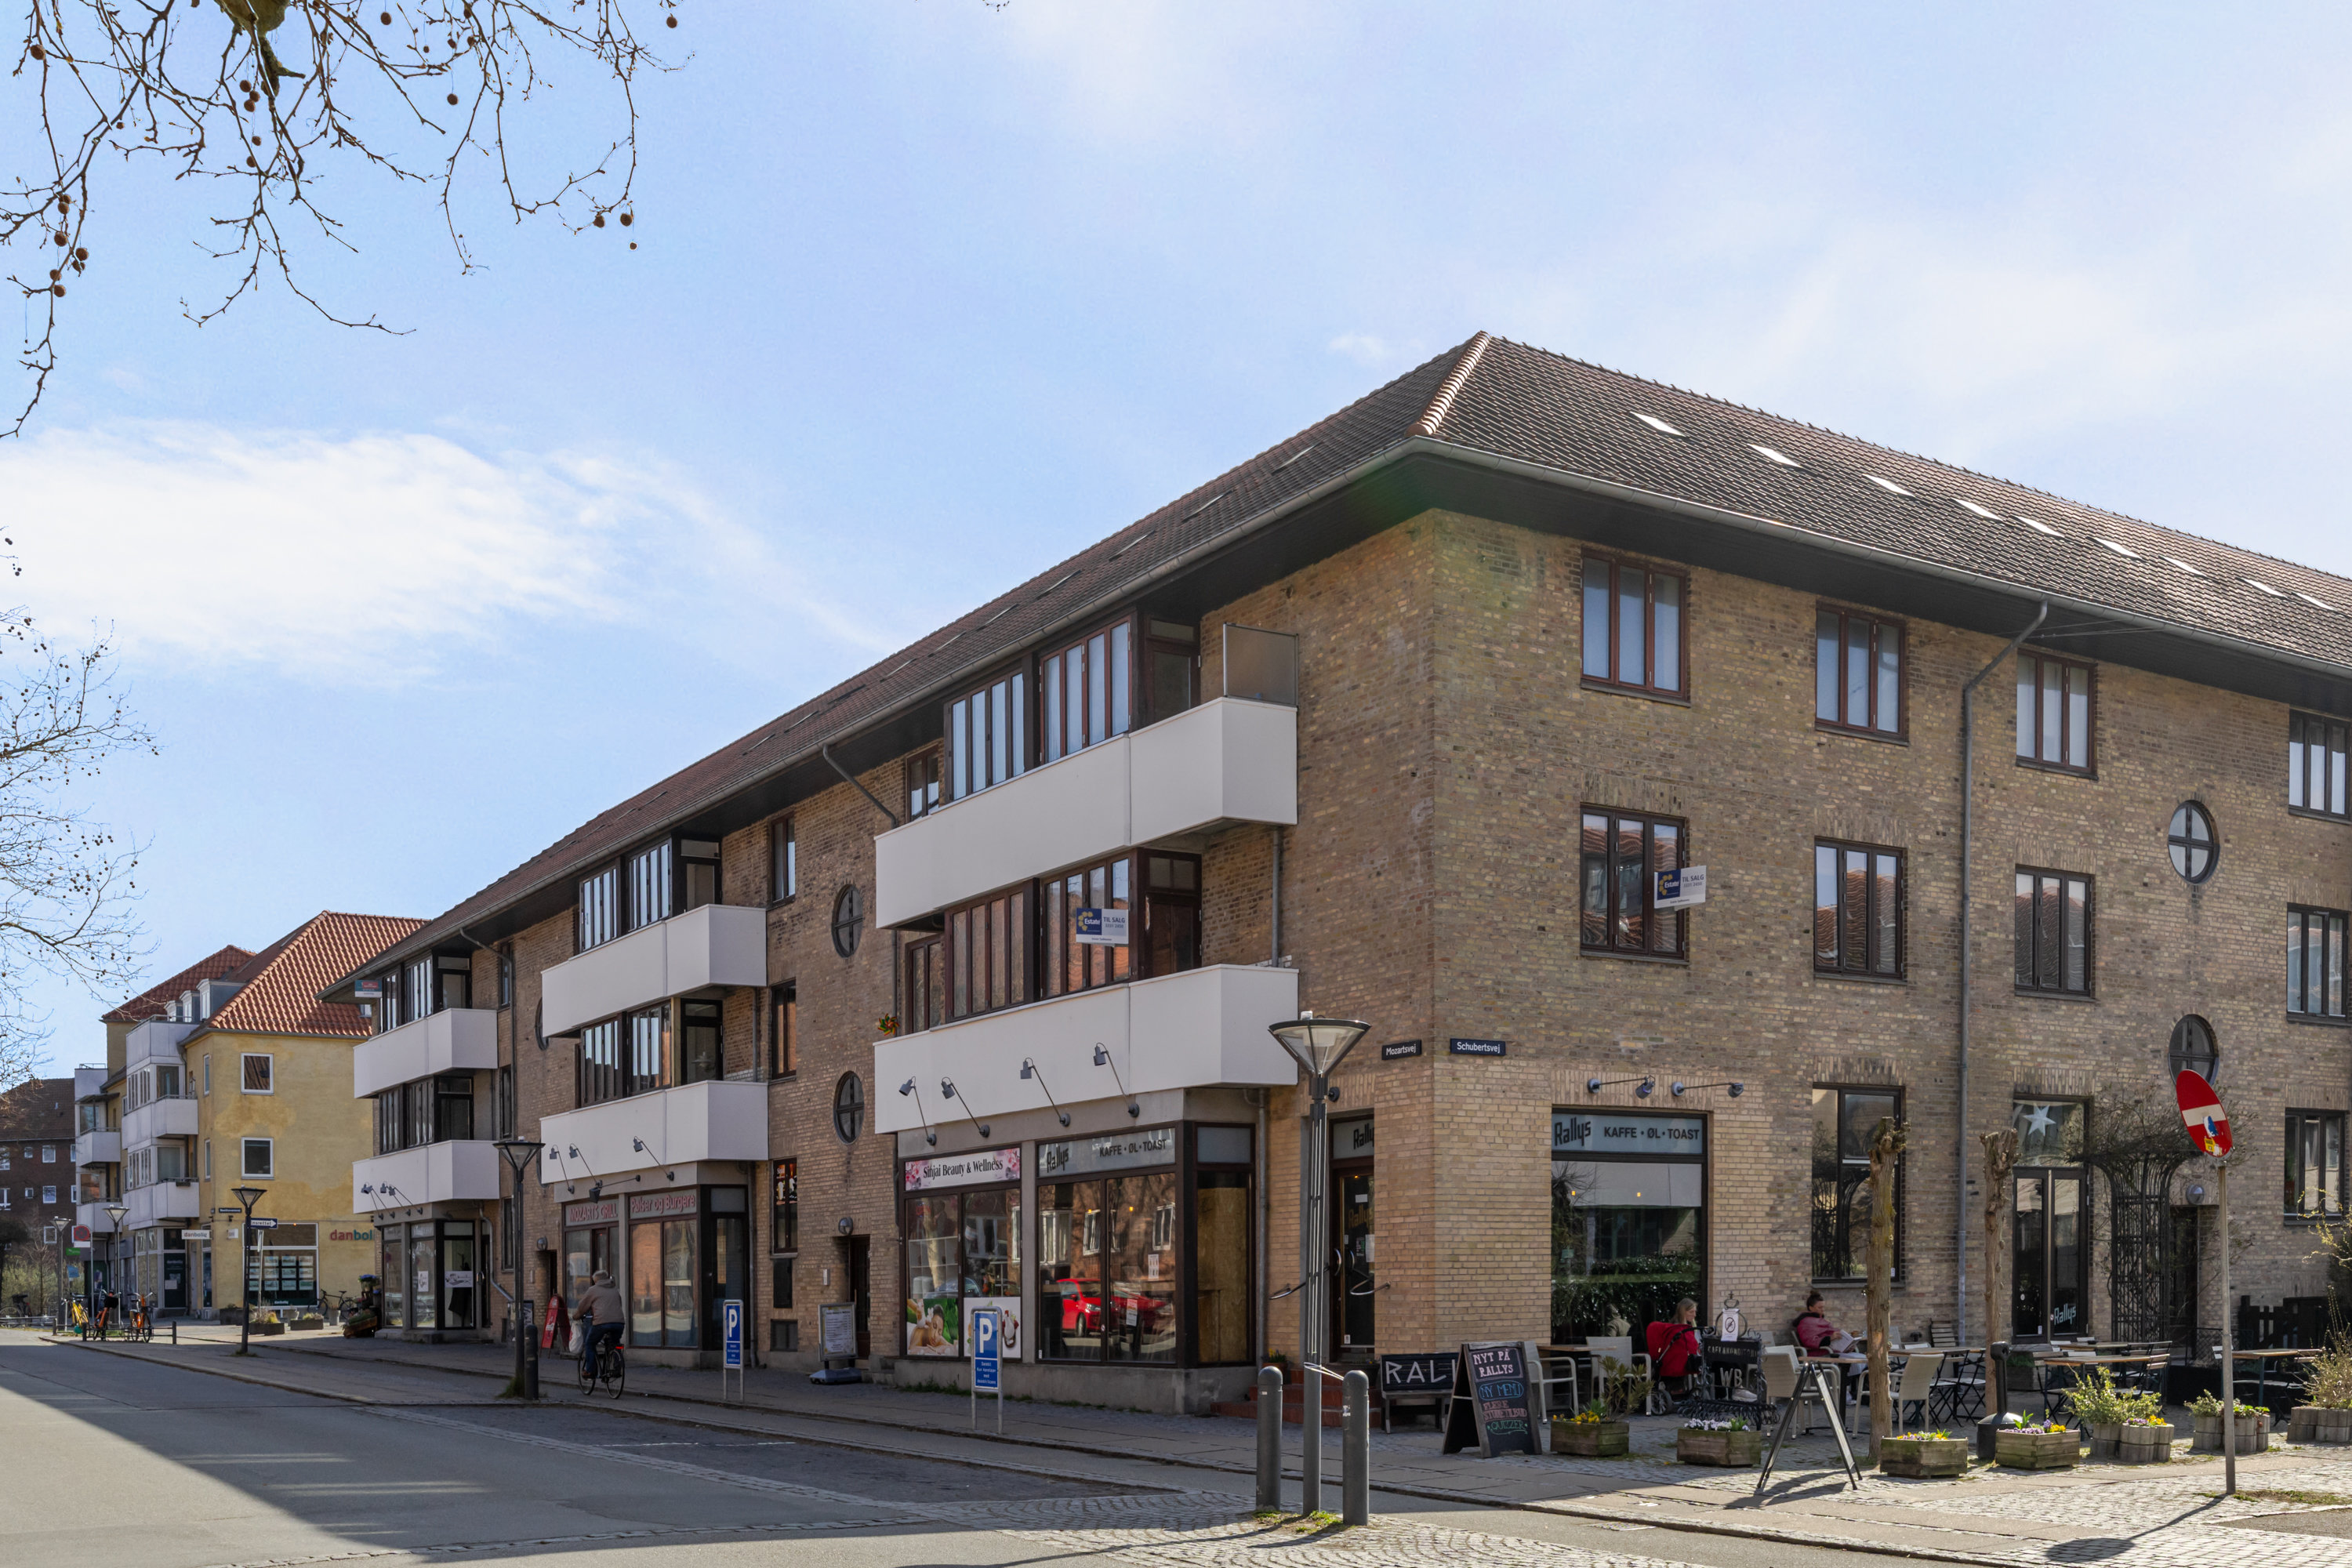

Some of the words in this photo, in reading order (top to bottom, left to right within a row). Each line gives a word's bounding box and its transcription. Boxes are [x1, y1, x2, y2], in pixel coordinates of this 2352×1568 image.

[1385, 1044, 1417, 1056] Mozartsvej
[1457, 1041, 1501, 1054] Schubertsvej
[1554, 1116, 1592, 1147] Rallys
[1604, 1127, 1637, 1138] KAFFE
[1647, 1127, 1661, 1139] ØL
[1668, 1128, 1700, 1140] TOAST
[1047, 1145, 1069, 1174] Rallys
[1099, 1145, 1122, 1157] KAFFE
[1128, 1141, 1138, 1153] ØL
[1143, 1139, 1167, 1152] TOAST
[923, 1163, 942, 1180] Sinjai
[942, 1163, 966, 1177] Beauty
[967, 1162, 972, 1174] &
[972, 1159, 1004, 1173] Wellness
[569, 1205, 599, 1222] MOZARTS
[601, 1203, 618, 1219] GRILL
[631, 1197, 652, 1214] Pølser
[654, 1200, 664, 1214] og
[666, 1194, 696, 1213] Burgere
[728, 1308, 738, 1338] P
[2054, 1303, 2077, 1325] Rallys
[979, 1318, 993, 1354] P
[1472, 1352, 1494, 1365] NYT
[1498, 1348, 1511, 1360] PÅ
[1479, 1364, 1514, 1377] RALLYS
[1719, 1367, 1743, 1388] WB
[1480, 1385, 1494, 1397] NY
[1496, 1383, 1521, 1396] MENU
[1483, 1400, 1509, 1410] FLERE
